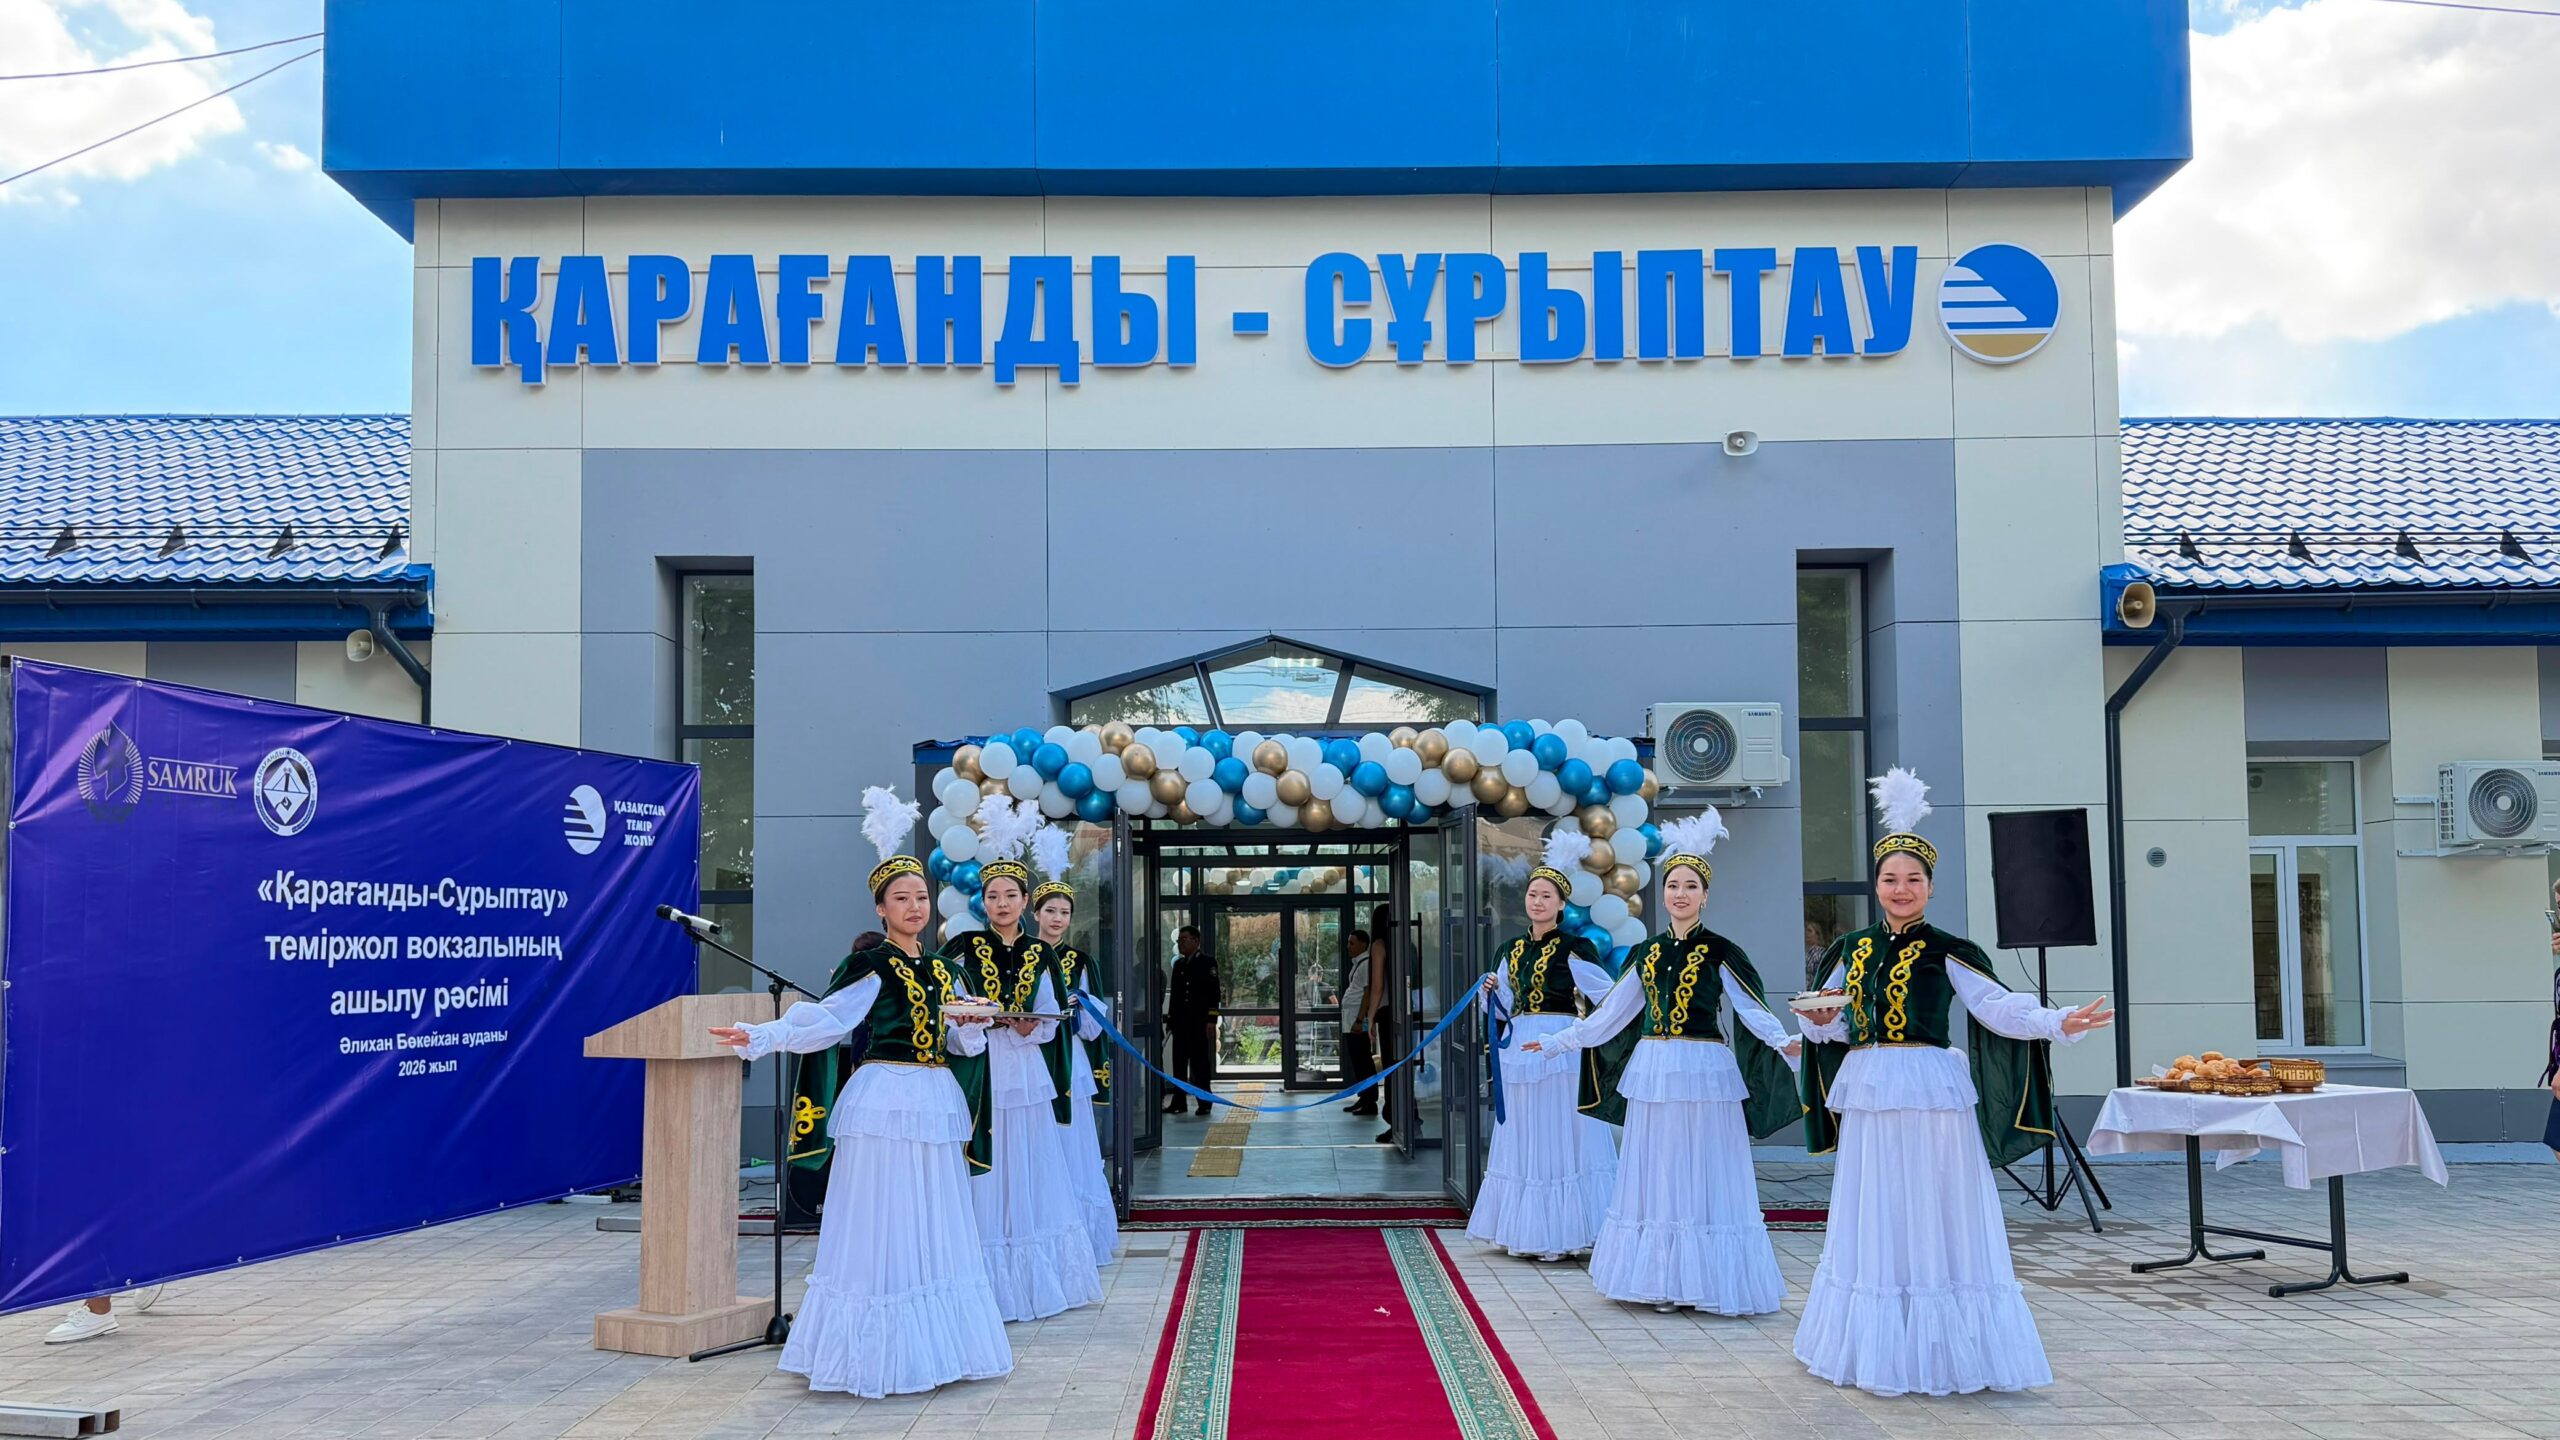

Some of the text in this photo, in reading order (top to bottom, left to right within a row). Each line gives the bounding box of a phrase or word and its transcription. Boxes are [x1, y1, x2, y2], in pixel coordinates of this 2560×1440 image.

[472, 254, 1199, 385] ҚАРАҒАНДЫ
[1305, 246, 1918, 367] СҰРЫПТАУ
[148, 760, 238, 795] SAMRUK
[613, 799, 667, 817] ҚАЗАҚСТАН
[625, 818, 653, 832] ТЕМІР
[257, 869, 568, 917] «Қарағанды-Сұрыптау»
[264, 927, 563, 969] теміржол вокзалының
[330, 977, 509, 1020] ашылу рәсімі
[339, 1029, 508, 1054] Әлихан Бөкейхан ауданы
[398, 1059, 458, 1077] 2026 жыл
